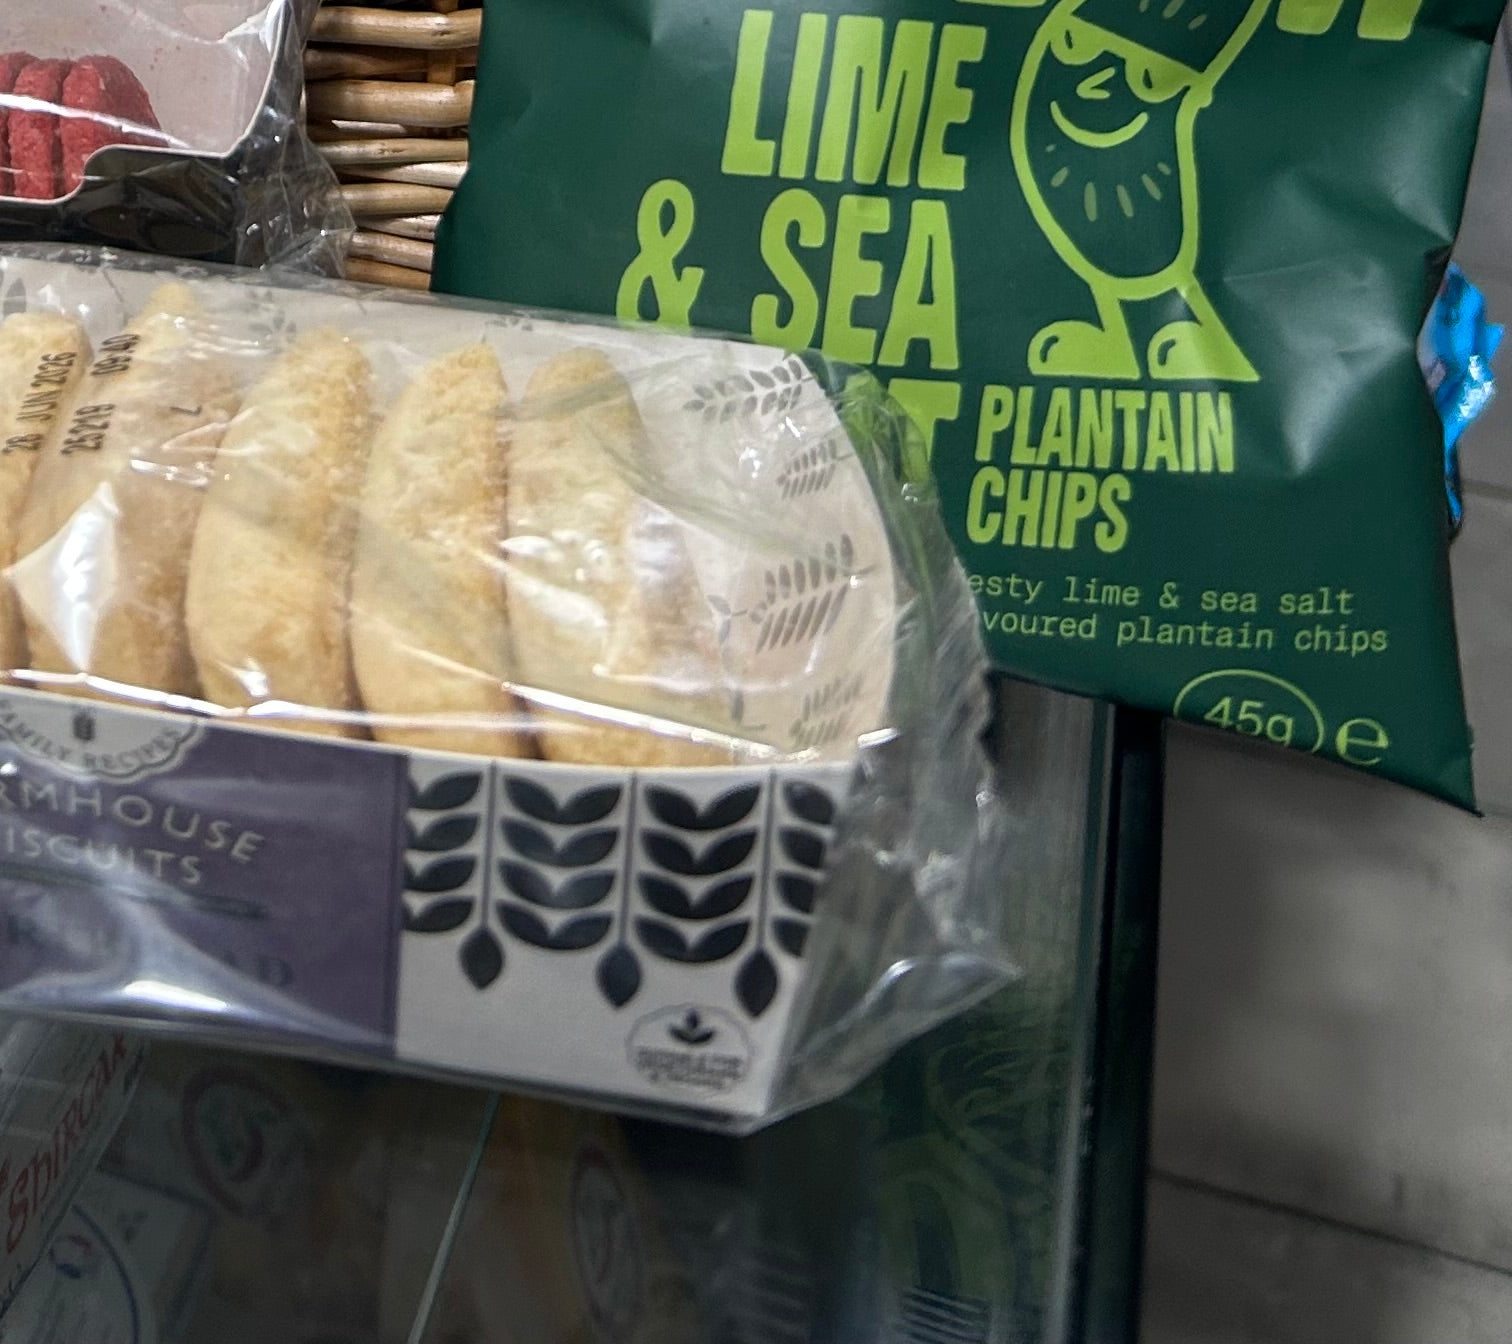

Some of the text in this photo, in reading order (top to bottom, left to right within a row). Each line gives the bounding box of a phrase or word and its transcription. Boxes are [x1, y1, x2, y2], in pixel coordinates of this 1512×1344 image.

[720, 9, 989, 190] LIME
[616, 179, 959, 372] & SEA
[30, 351, 78, 387] 2026
[16, 389, 63, 421] JUN
[975, 384, 1236, 474] PLANTAIN
[965, 466, 1132, 555] CHIPS
[1063, 575, 1140, 606] lime
[1158, 581, 1180, 610] &
[1200, 588, 1259, 614] sea
[1279, 586, 1355, 615] salt
[1116, 617, 1273, 650] plantain
[1294, 624, 1388, 657] chips
